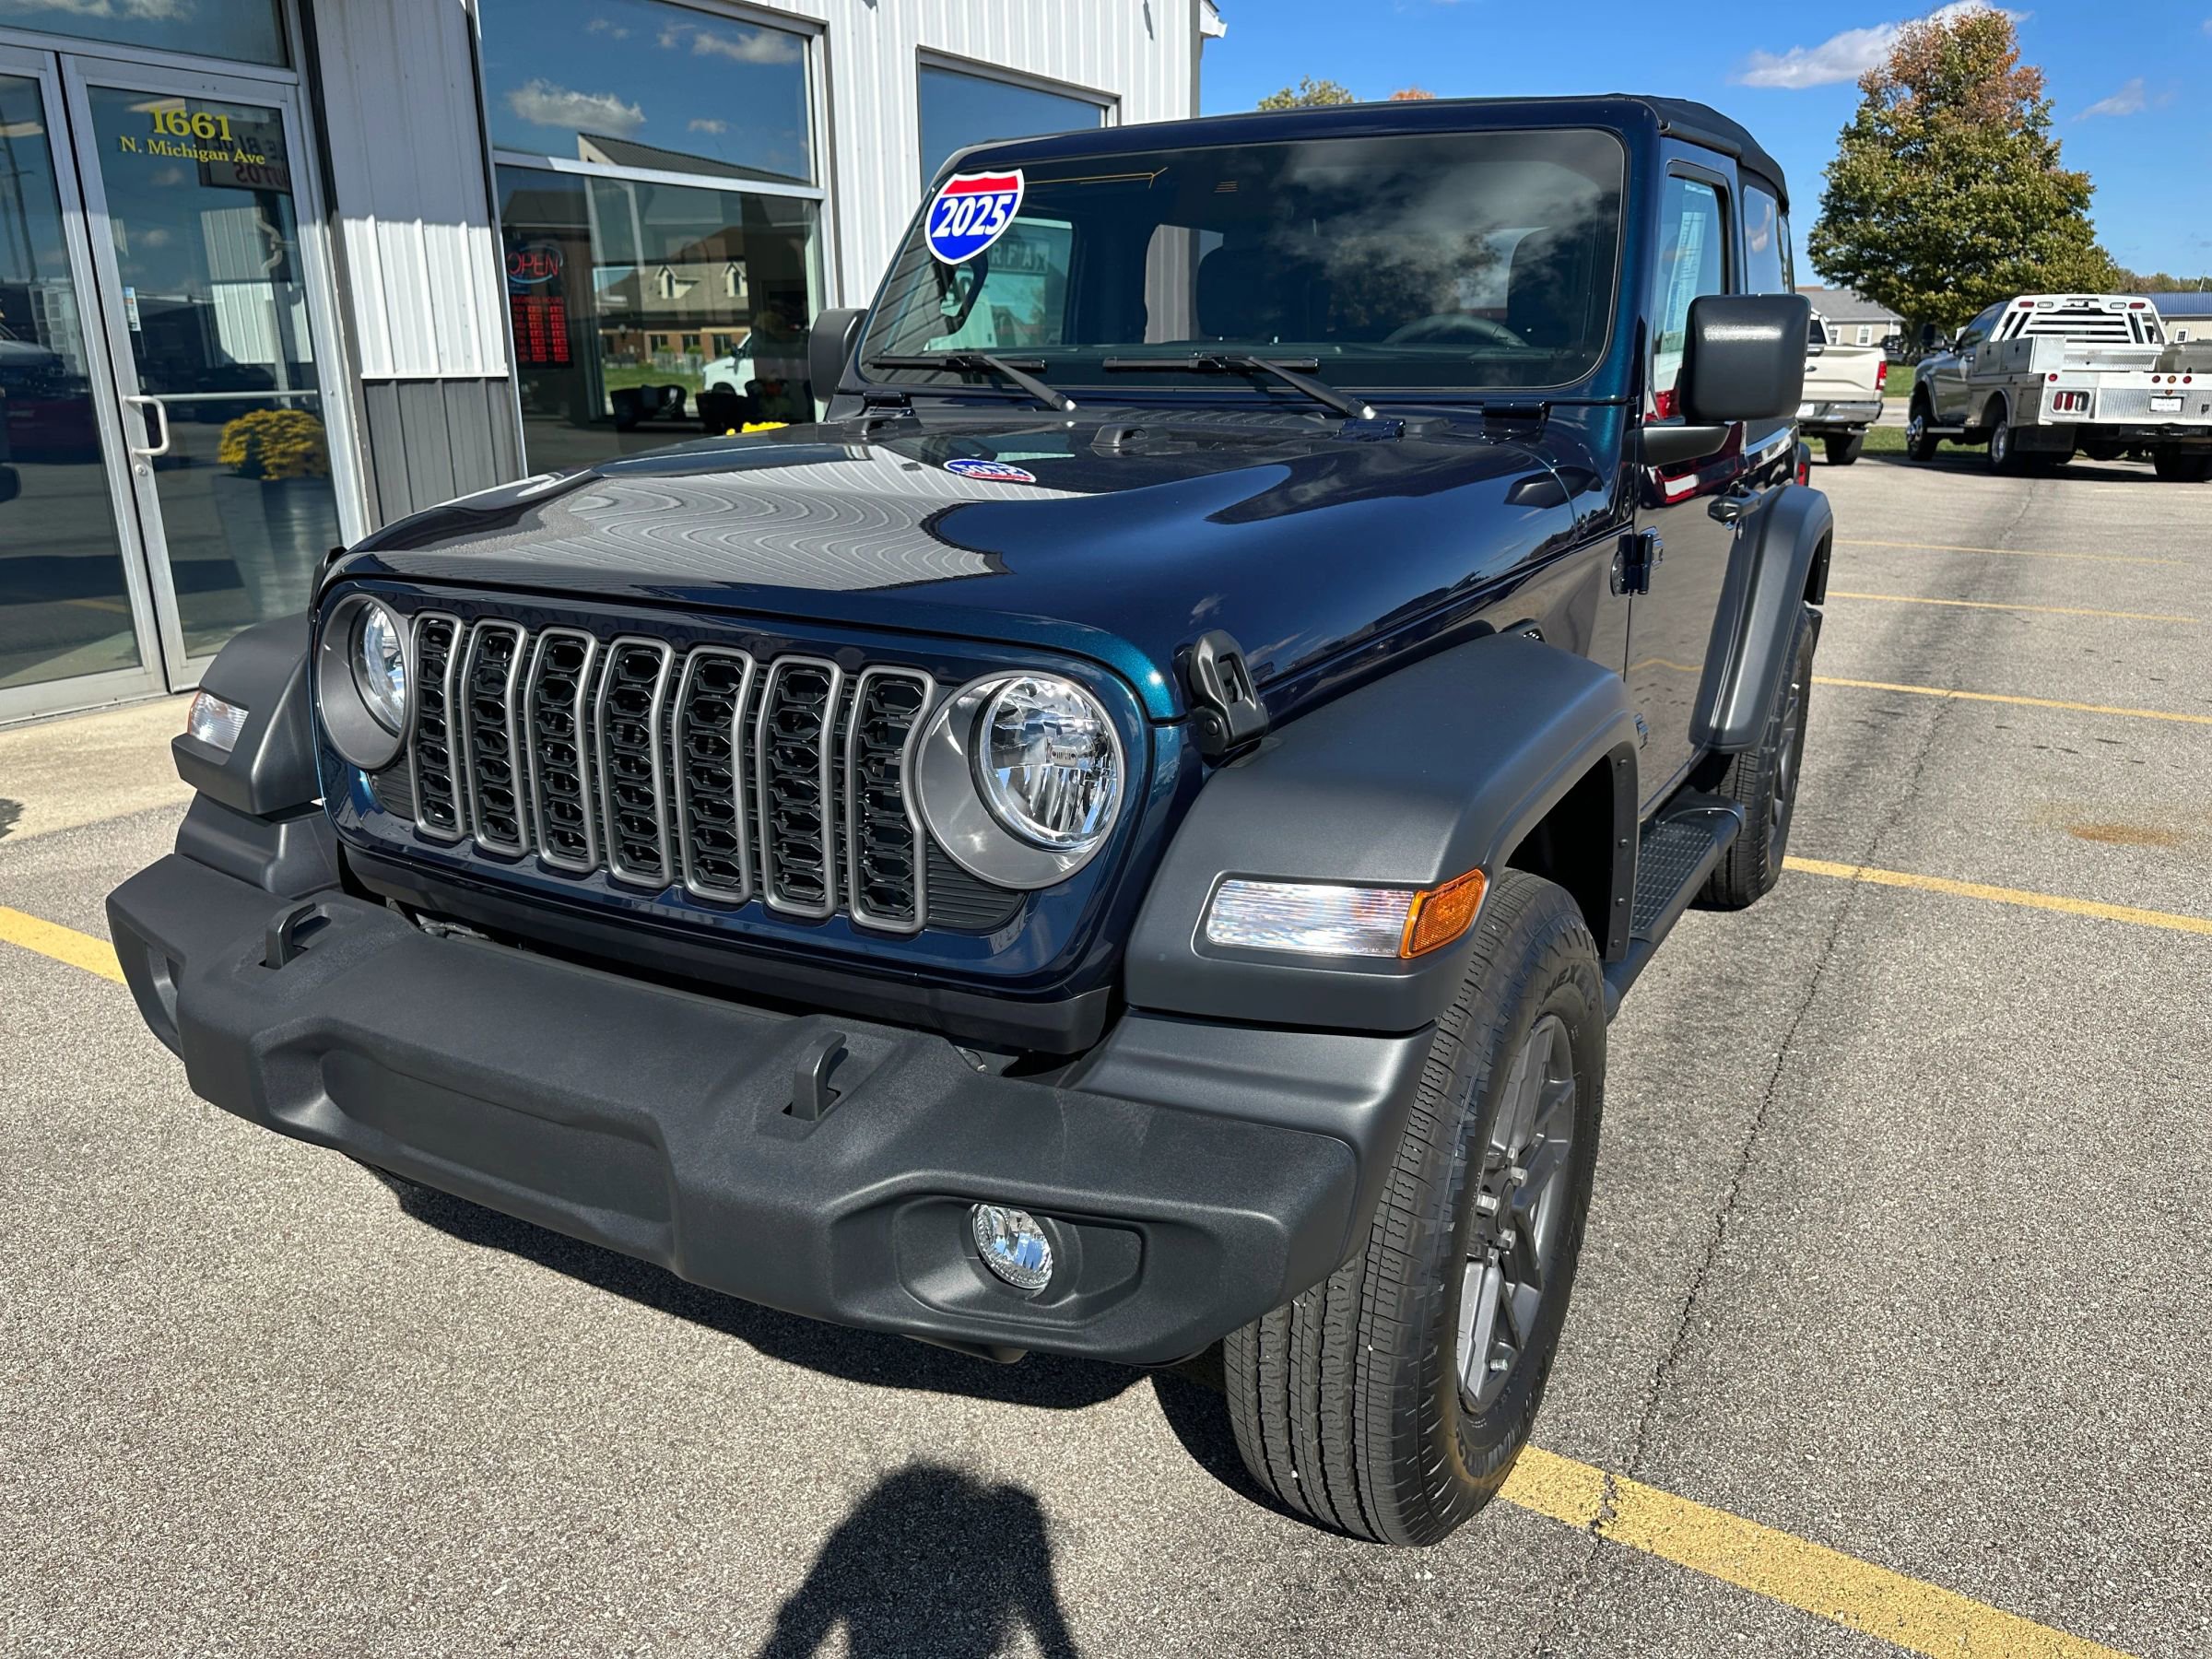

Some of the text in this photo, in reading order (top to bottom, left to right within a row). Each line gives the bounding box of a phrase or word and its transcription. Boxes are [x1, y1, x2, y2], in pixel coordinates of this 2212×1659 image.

[149, 106, 233, 141] 1661
[120, 135, 143, 154] N.
[147, 138, 229, 163] Michigan
[233, 148, 266, 165] Ave
[932, 194, 1013, 238] 2025
[507, 252, 559, 276] OPEN
[991, 242, 1049, 273] RFAX
